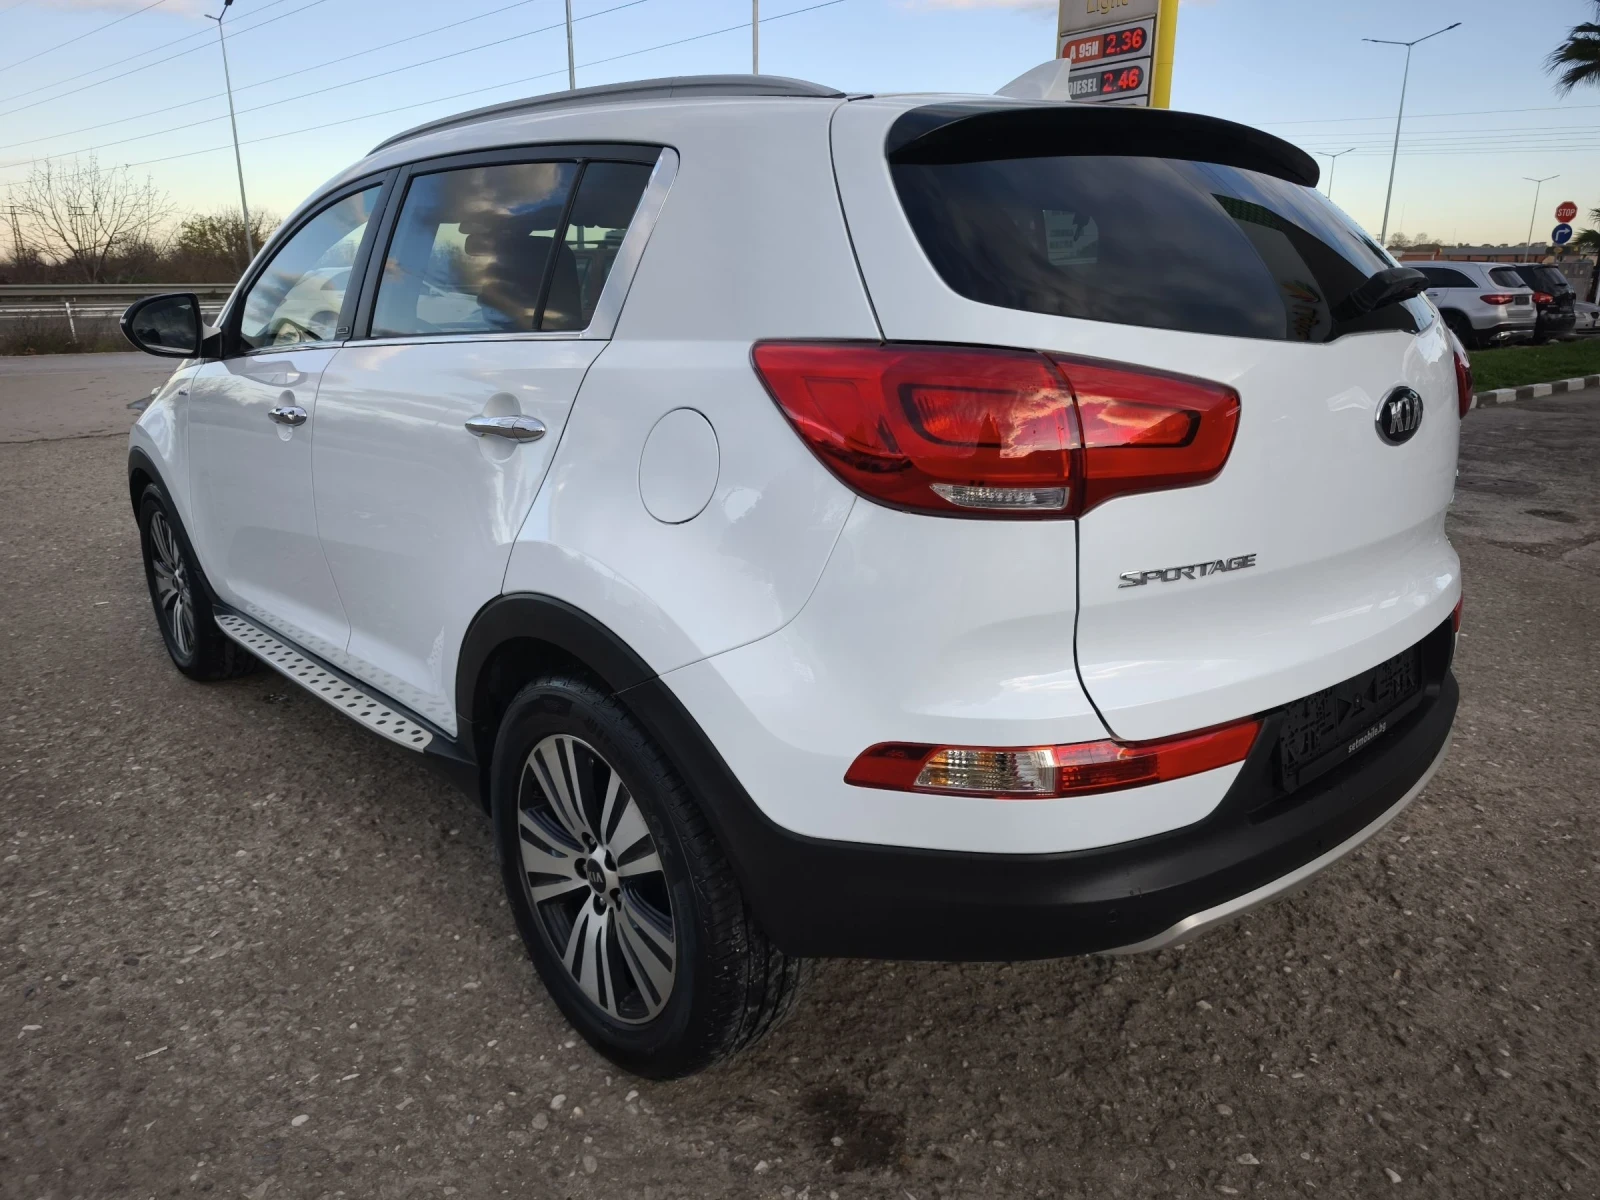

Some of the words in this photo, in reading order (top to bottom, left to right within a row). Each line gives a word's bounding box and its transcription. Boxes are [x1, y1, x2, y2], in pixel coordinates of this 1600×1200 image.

[1069, 45, 1076, 60] A
[1106, 28, 1143, 54] 2.36
[1068, 78, 1097, 95] DIESEL
[1102, 68, 1139, 92] 2.46
[1557, 208, 1576, 217] STOP
[1389, 397, 1420, 434] KIA
[1118, 553, 1257, 589] SPORTAGE
[1348, 721, 1387, 753] setmobile.bg
[588, 871, 604, 883] KIA
